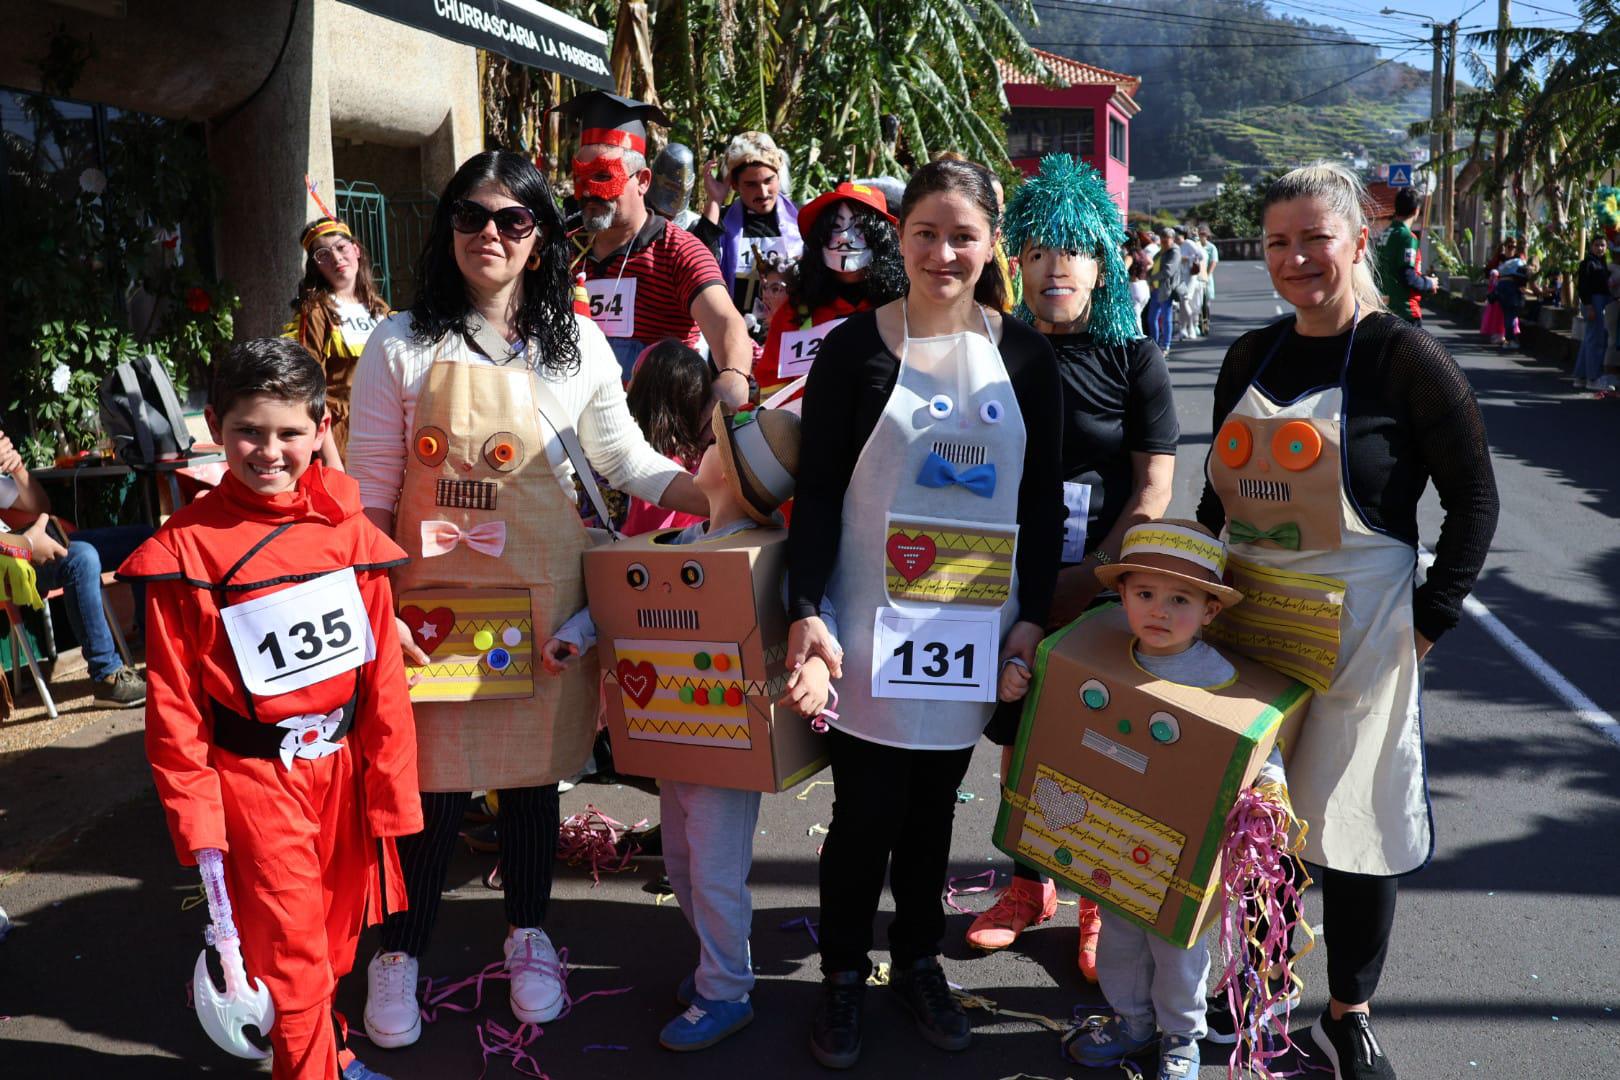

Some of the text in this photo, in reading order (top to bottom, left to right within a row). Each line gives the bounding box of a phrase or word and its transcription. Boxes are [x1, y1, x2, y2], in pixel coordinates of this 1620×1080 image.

[434, 0, 610, 76] CHURRASCARIA LA PARREIRA
[791, 337, 824, 358] 12
[257, 608, 352, 669] 135
[894, 640, 975, 679] 131
